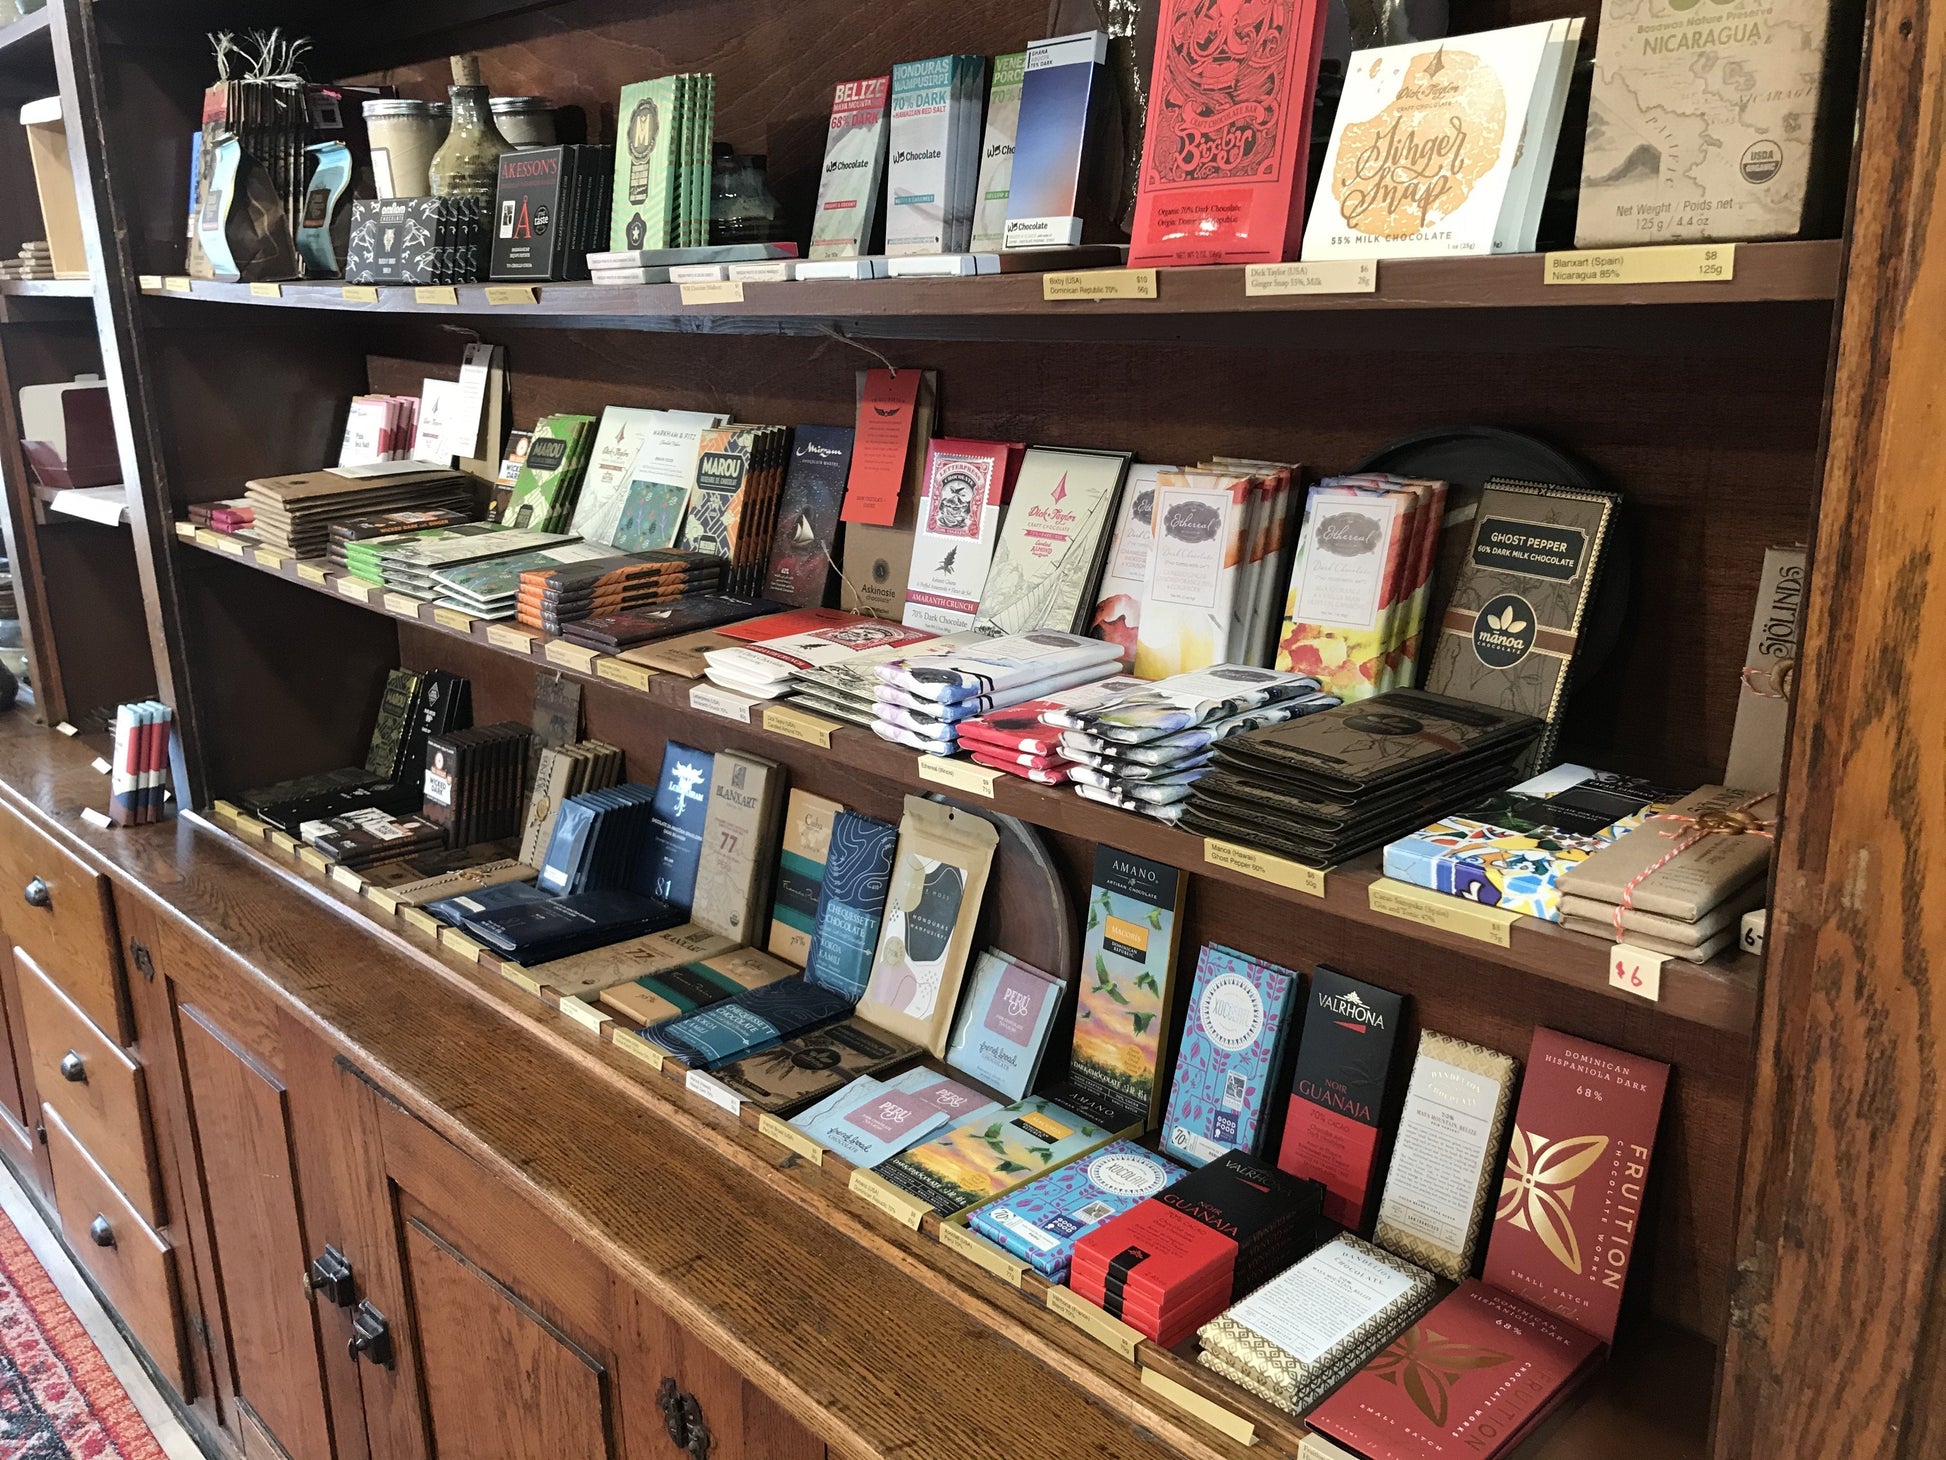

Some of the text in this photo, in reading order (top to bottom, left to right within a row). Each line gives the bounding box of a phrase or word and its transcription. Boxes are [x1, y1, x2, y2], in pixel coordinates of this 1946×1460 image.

[1686, 13, 1724, 28] Nature
[1642, 22, 1763, 56] NICARAGUA
[894, 58, 950, 81] HONDURAS
[834, 78, 886, 104] BELIZE
[894, 72, 950, 92] WAMPUSIRPI
[893, 90, 947, 111] 70% DARK
[831, 111, 879, 129] 68% DARK
[906, 149, 942, 161] Chocolate
[1174, 126, 1253, 171] Bixby
[1341, 115, 1467, 187] Ginger
[1750, 150, 1774, 161] USDA
[838, 159, 869, 170] Chocolate
[1341, 166, 1453, 229] Snap
[1616, 198, 1734, 218] Net Weight Poids net
[1018, 221, 1048, 231] Chocolate
[1636, 217, 1654, 231] 125
[1331, 231, 1453, 245] 55% MILK CHOCOLATE
[1552, 250, 1718, 269] Blanxart (Spain) $8
[1049, 277, 1064, 286] Bixby
[1065, 277, 1082, 285] (USA)
[1251, 268, 1266, 277] Dick
[1267, 268, 1286, 278] Taylor
[1287, 266, 1308, 277] (USA)
[1552, 264, 1723, 282] Nicaragua 85% 125g
[1050, 287, 1079, 295] Dominican
[1251, 280, 1273, 290] Ginger
[532, 441, 564, 458] MAROU
[701, 456, 741, 478] MAROU
[938, 462, 982, 484] LETTERPRESS
[944, 473, 976, 488] CHOCOLATE
[1028, 505, 1076, 526] Dick Taylor
[1170, 513, 1213, 531] Ethereal
[1322, 525, 1374, 544] Ethereal
[1490, 531, 1568, 553] GHOST PEPPER
[1478, 544, 1575, 568] 60% DARK MILK CHOCOLATE
[861, 583, 896, 599] Askinosie
[912, 593, 974, 611] AMARANTH CRUNCH
[911, 609, 968, 628] 70% Dark Chocolate
[1476, 640, 1522, 655] CHOCOLATE
[1478, 630, 1525, 650] mānoa
[716, 784, 757, 809] BLANXART
[720, 831, 738, 854] 77
[1211, 843, 1257, 863] Manoa (Hawaii)
[1211, 852, 1252, 869] Ghost Pepper
[1112, 859, 1156, 882] AMANO
[655, 875, 672, 898] 81
[1106, 879, 1158, 900] ARTISAN CHOCOLATE
[826, 914, 866, 938] CHOCOLATE
[828, 902, 877, 930] CHEQUESSETT
[912, 914, 949, 931] HONDURAS
[819, 949, 841, 966] KAMILI
[1111, 940, 1138, 955] DOMINICAN
[1113, 946, 1135, 958] REPUBLIC
[715, 1007, 759, 1033] CHOCOLATE
[1318, 991, 1385, 1030] VALRHONA
[1564, 1049, 1631, 1076] DOMINICAN
[1088, 1068, 1121, 1087] CHOCOLATE
[1431, 1071, 1481, 1094] DANDELION
[1544, 1054, 1648, 1093] HISPANIOLA DARK
[1325, 1078, 1348, 1094] NOIR
[1576, 1085, 1603, 1102] 68%
[1069, 1093, 1115, 1116] AMANO
[1299, 1080, 1371, 1121] GUANAJA
[1215, 1121, 1236, 1136] FOOD
[1217, 1115, 1237, 1130] GOOD
[1310, 1108, 1351, 1133] 70% CACAO
[1225, 1159, 1297, 1197] VALRHONA
[1163, 1194, 1239, 1236] GUANAJA
[1198, 1201, 1222, 1216] NOIR
[1589, 1140, 1624, 1282] CHOCOLATE WORKS
[1602, 1143, 1648, 1290] FRUITION
[1052, 1220, 1073, 1234] FOOD
[1057, 1217, 1077, 1231] GOOD
[1334, 1257, 1384, 1285] CHOCOLATE
[1342, 1251, 1392, 1280] DANDELION
[1510, 1269, 1545, 1289] SMALL
[1553, 1287, 1590, 1307] BATCH
[1470, 1292, 1536, 1329] HISPANIOLA
[1539, 1326, 1572, 1346] DARK
[1492, 1295, 1558, 1332] DOMINICAN
[1495, 1318, 1523, 1337] 68%
[1450, 1361, 1533, 1439] CHOCOLATE WORKS
[1463, 1370, 1554, 1452] FRUITION
[1359, 1403, 1443, 1452] SMALL BATCH
